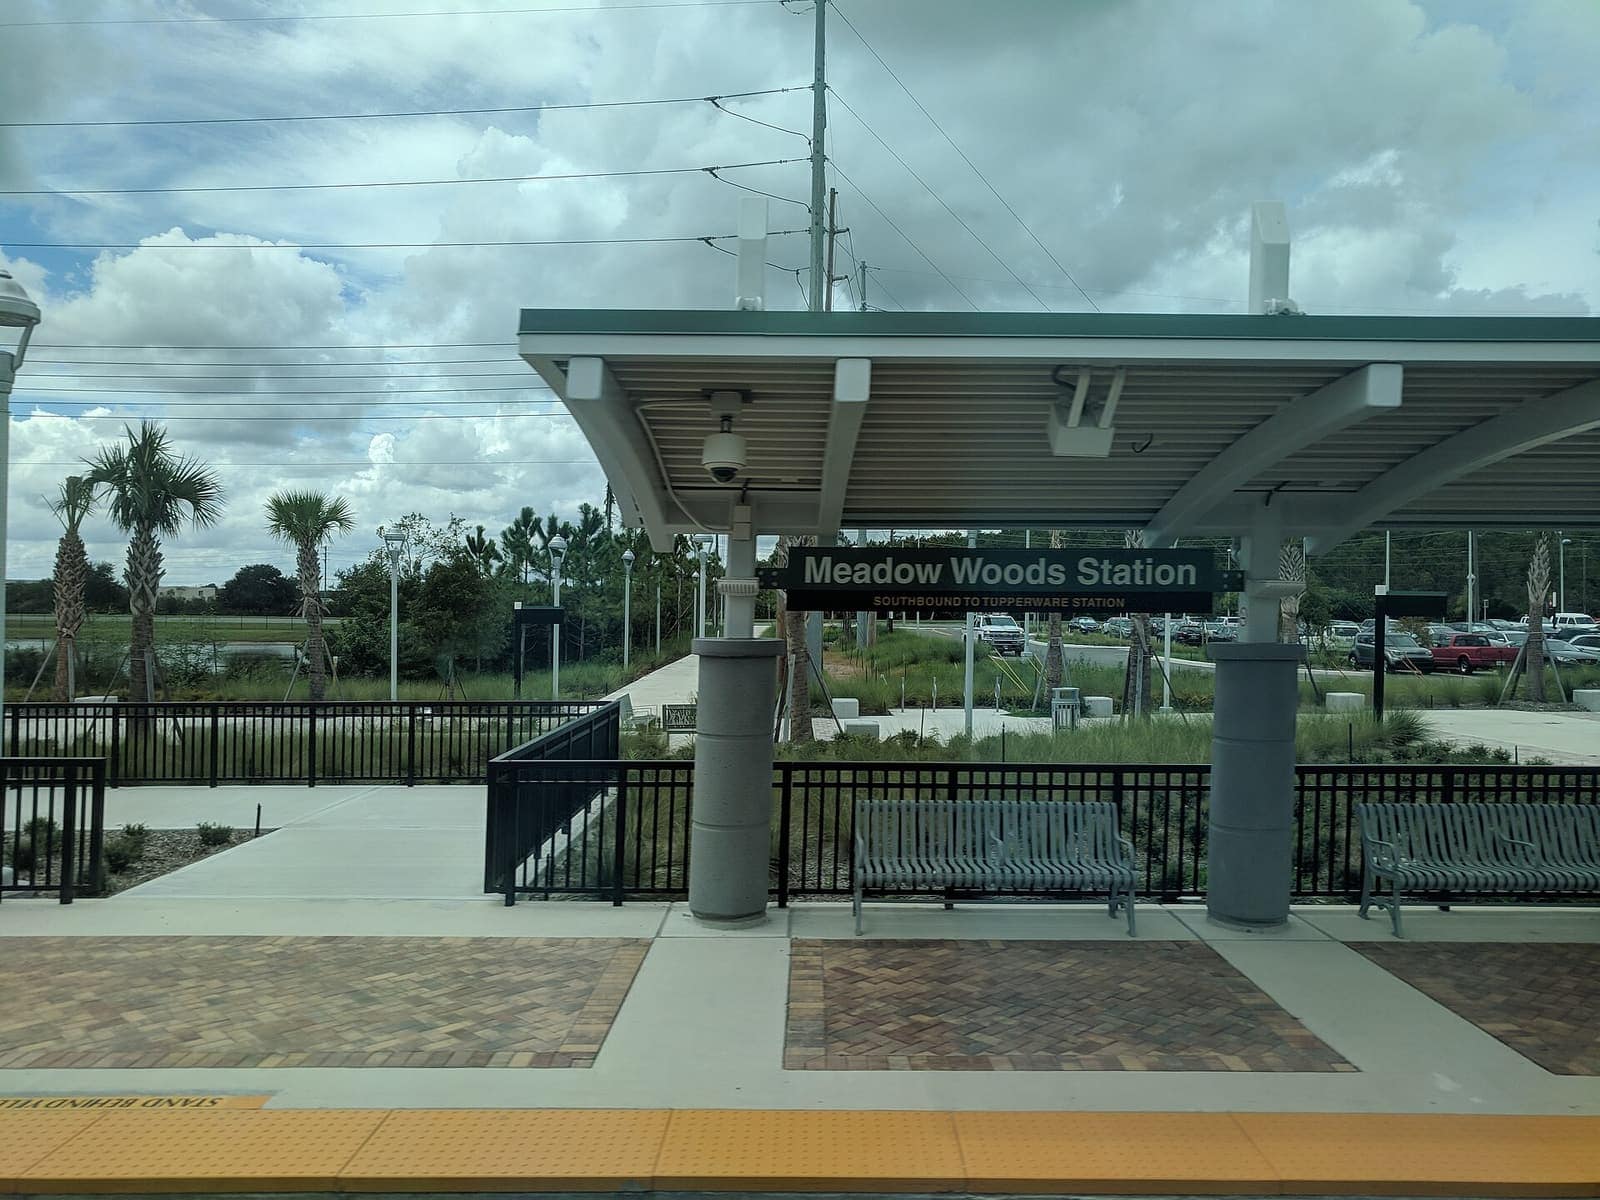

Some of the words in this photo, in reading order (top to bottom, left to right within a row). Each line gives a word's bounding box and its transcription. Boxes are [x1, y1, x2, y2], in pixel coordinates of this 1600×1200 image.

[804, 556, 943, 584] Meadow
[950, 557, 1066, 585] Woods
[1077, 557, 1197, 585] Station
[872, 596, 962, 607] SOUTHBOUND
[962, 597, 980, 607] TO
[981, 597, 1069, 608] TUPPERWARE
[1072, 598, 1125, 608] STATION
[45, 1098, 140, 1109] BEHIND
[141, 1097, 223, 1109] STAND
